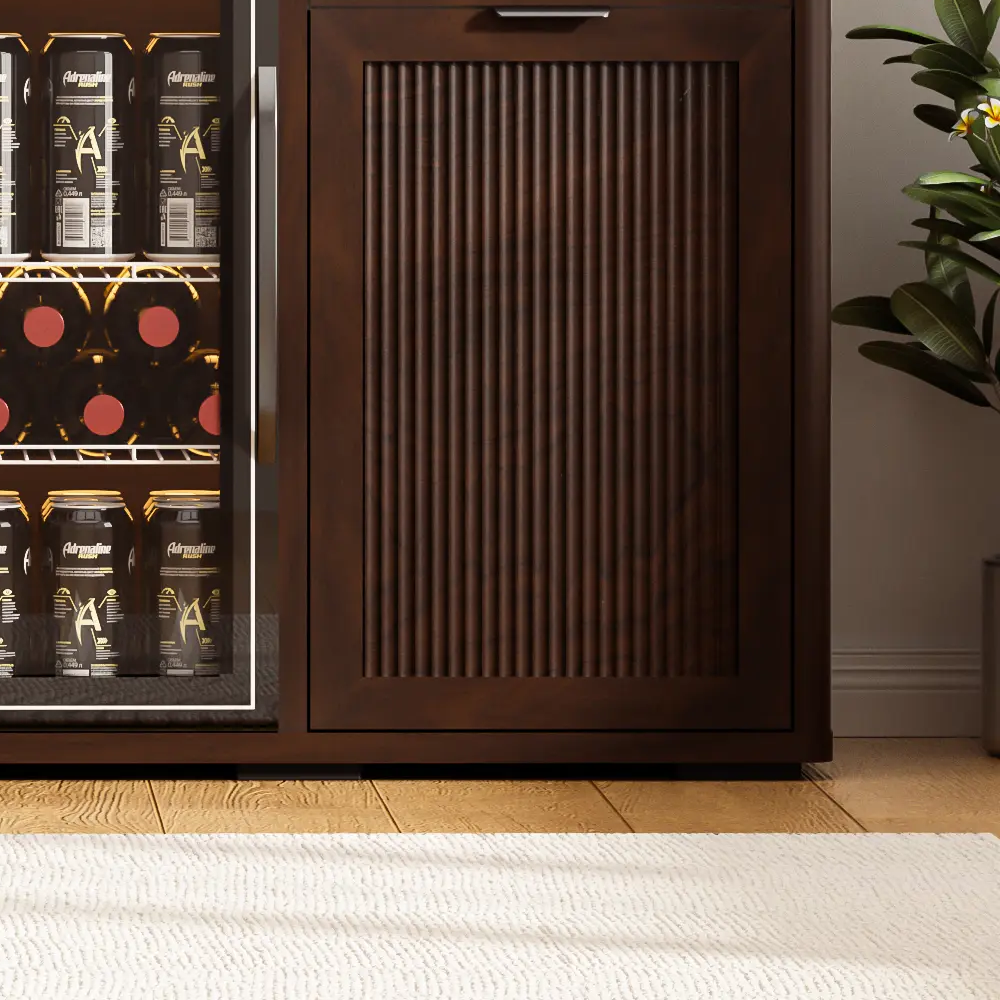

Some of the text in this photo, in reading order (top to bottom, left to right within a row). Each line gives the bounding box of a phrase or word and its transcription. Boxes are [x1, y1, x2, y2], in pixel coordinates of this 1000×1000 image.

[167, 71, 216, 87] Adrenaline
[63, 542, 112, 558] Adrenaline
[167, 542, 216, 558] Adrenaline
